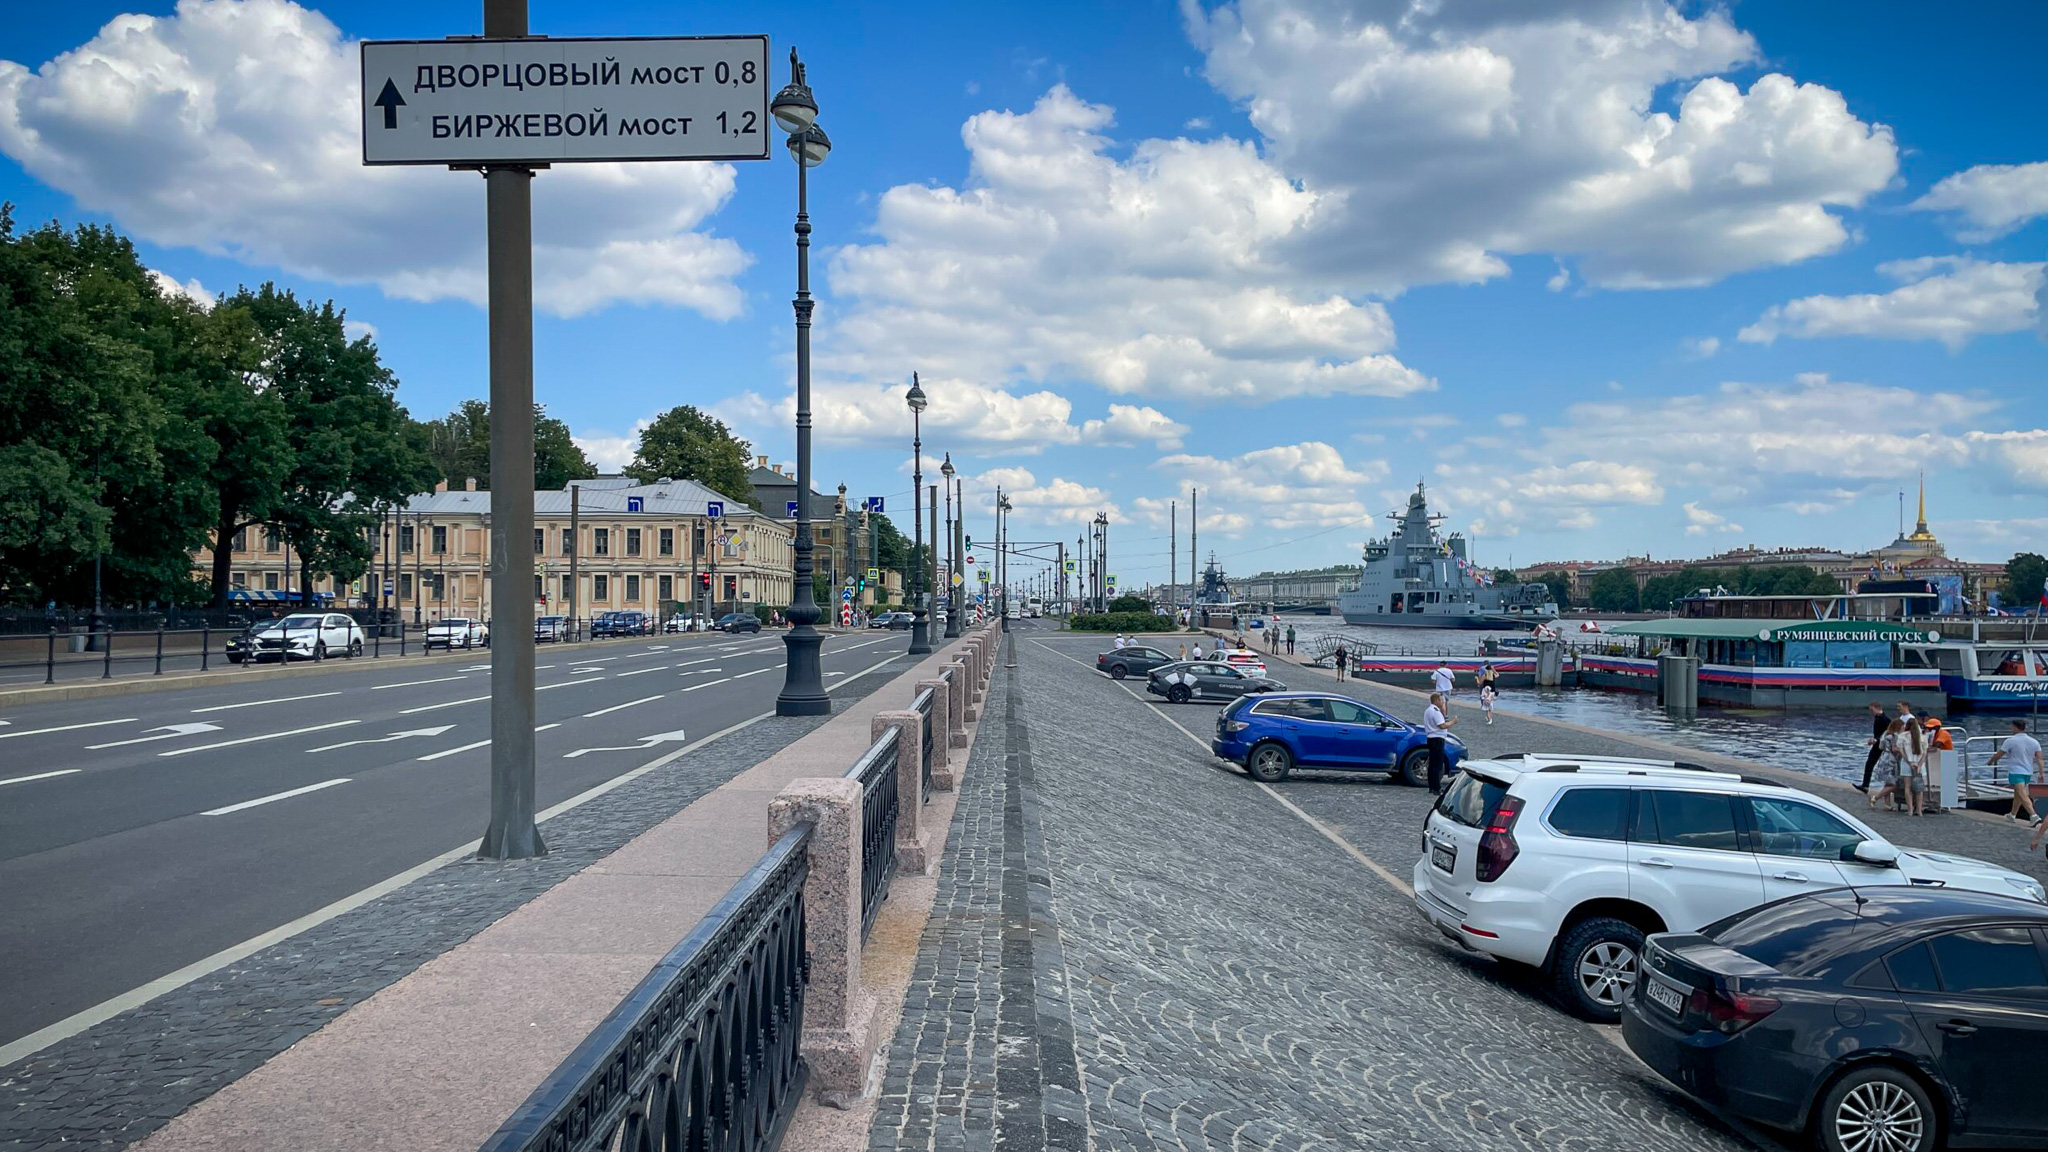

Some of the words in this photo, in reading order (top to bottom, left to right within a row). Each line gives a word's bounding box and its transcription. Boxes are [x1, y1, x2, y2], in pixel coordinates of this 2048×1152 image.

[414, 56, 620, 93] ДВОРЦОВЫЙ
[630, 66, 705, 85] мост
[714, 61, 757, 88] 0,8
[432, 107, 609, 139] БИРЖЕВОЙ
[618, 116, 692, 136] мост
[715, 110, 757, 138] 1,2
[1777, 629, 1877, 642] РУМЯНЦЕВСКИЙ
[1880, 631, 1922, 641] СПУСК
